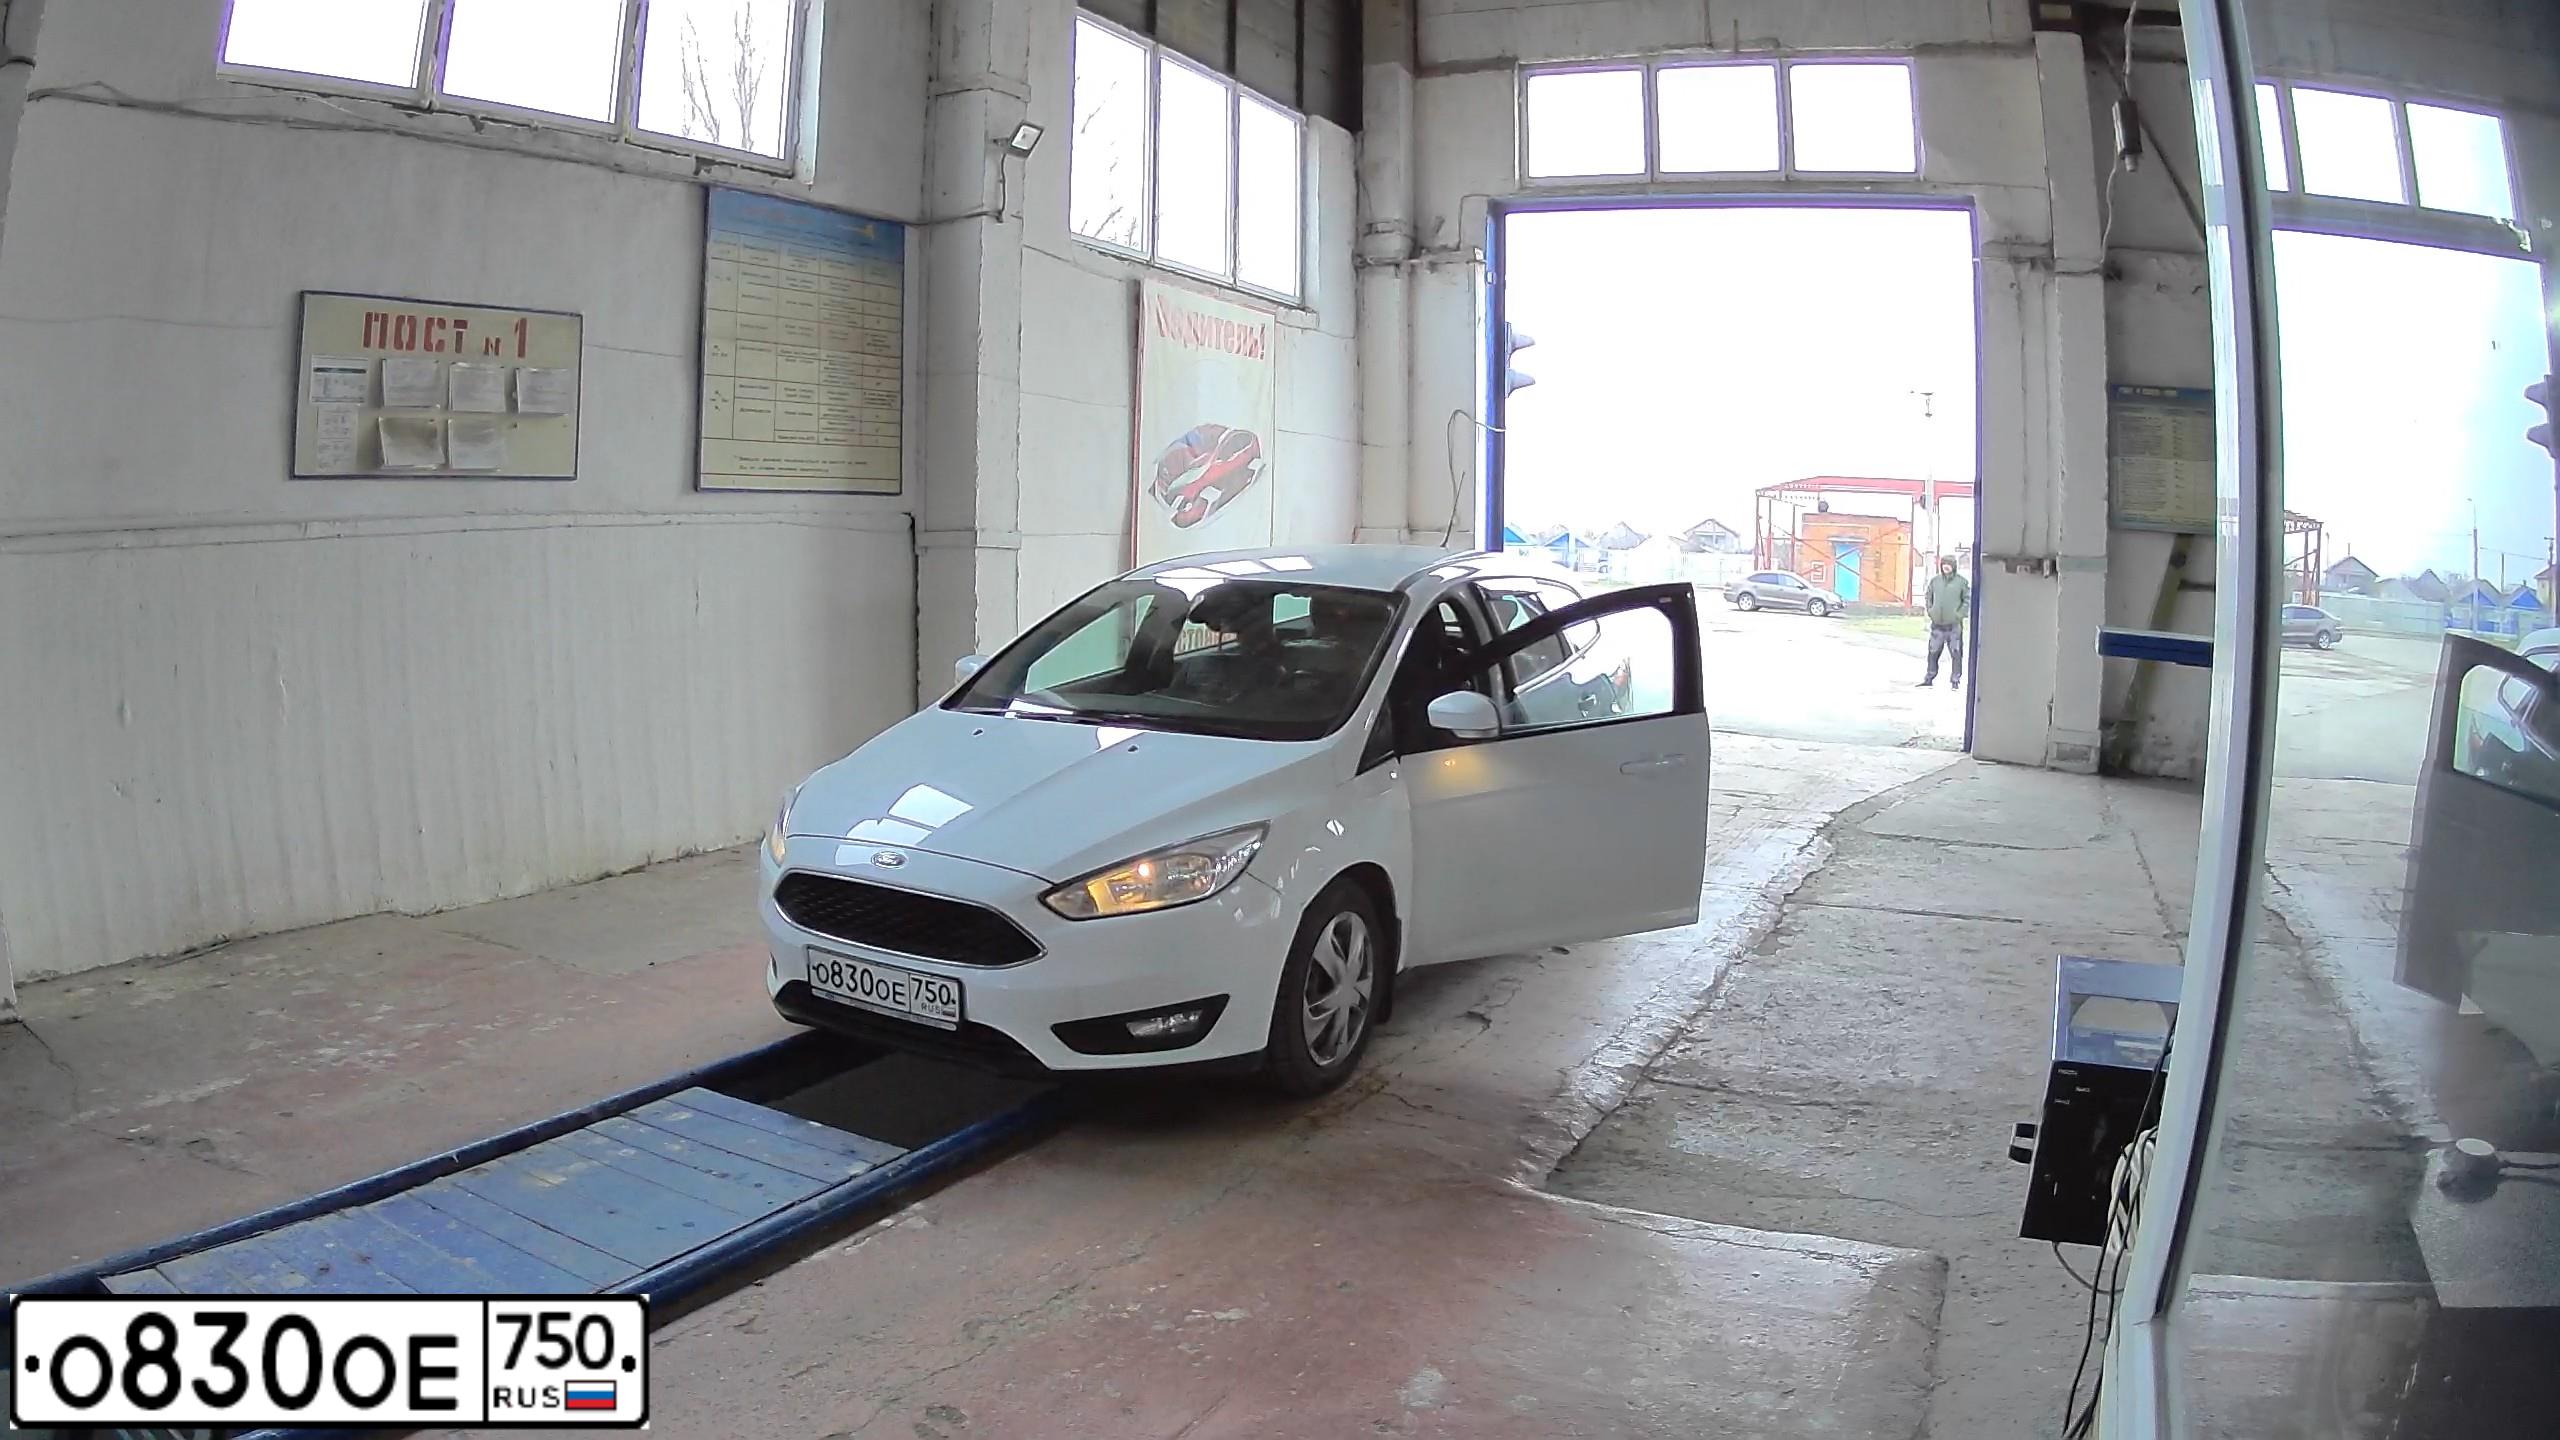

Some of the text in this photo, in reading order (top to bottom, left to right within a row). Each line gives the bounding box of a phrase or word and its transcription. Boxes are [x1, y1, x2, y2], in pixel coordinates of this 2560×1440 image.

[363, 311, 468, 353] ПОСТ
[514, 317, 528, 359] 1
[911, 978, 951, 1006] 750
